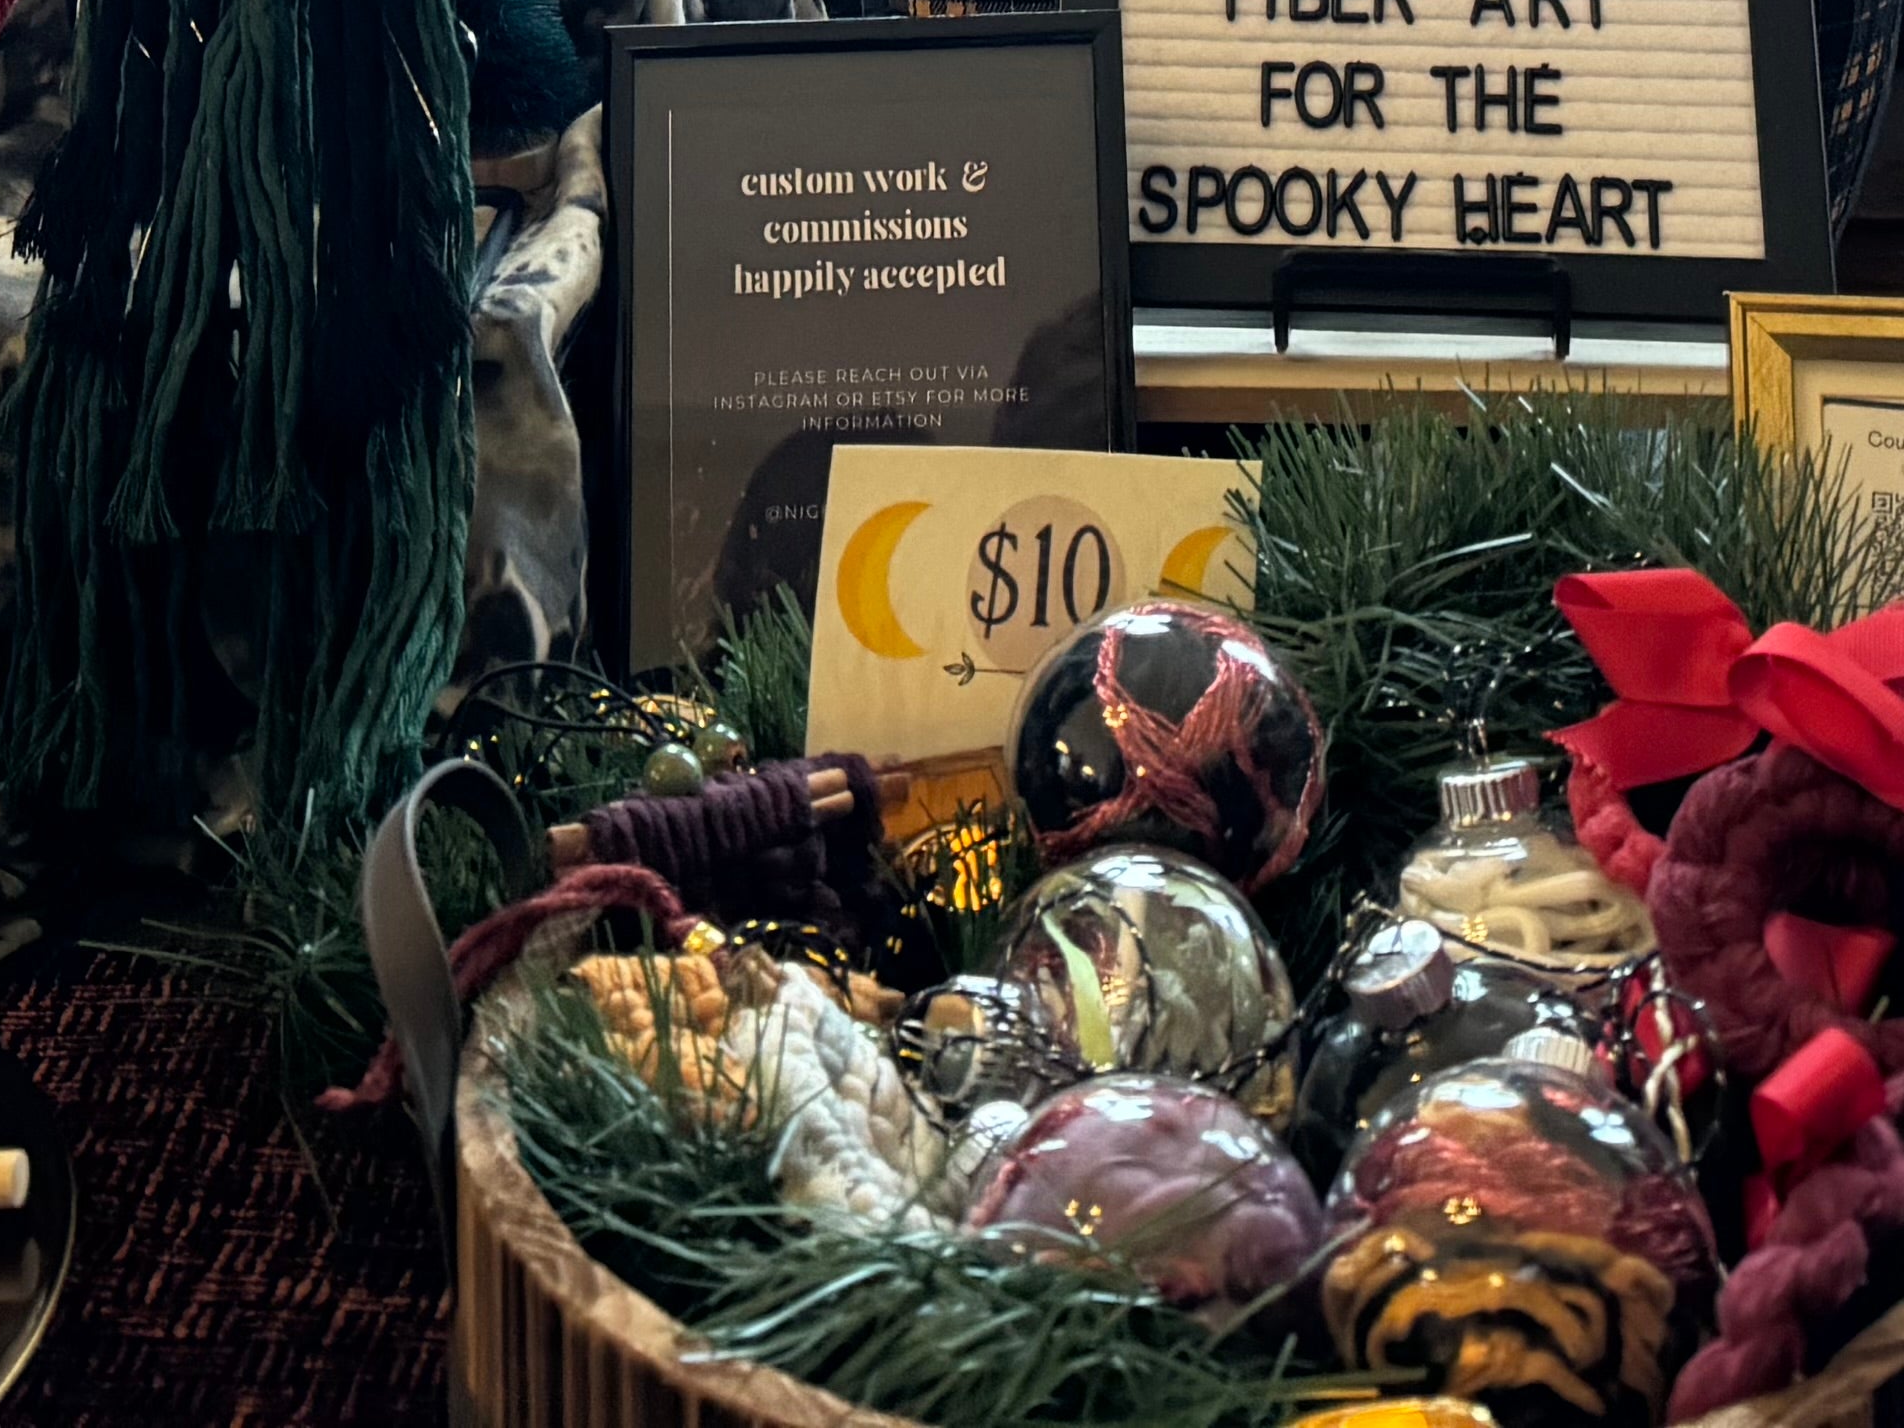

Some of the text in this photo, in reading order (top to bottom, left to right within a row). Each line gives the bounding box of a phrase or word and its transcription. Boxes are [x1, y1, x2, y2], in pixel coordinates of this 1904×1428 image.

[1259, 60, 1564, 136] FOR THE
[740, 159, 990, 197] custom work &
[763, 208, 969, 244] commissions
[1137, 164, 1674, 251] SPOOKY HEART
[733, 255, 1007, 300] happily accepted
[754, 364, 990, 386] PLEASE REACH OUT VIA
[713, 387, 1030, 410] INSTAGRAM OR ETSY FOR MORE
[802, 414, 943, 432] INFORMATION
[765, 504, 825, 523] @NIG
[970, 521, 1111, 640] $10
